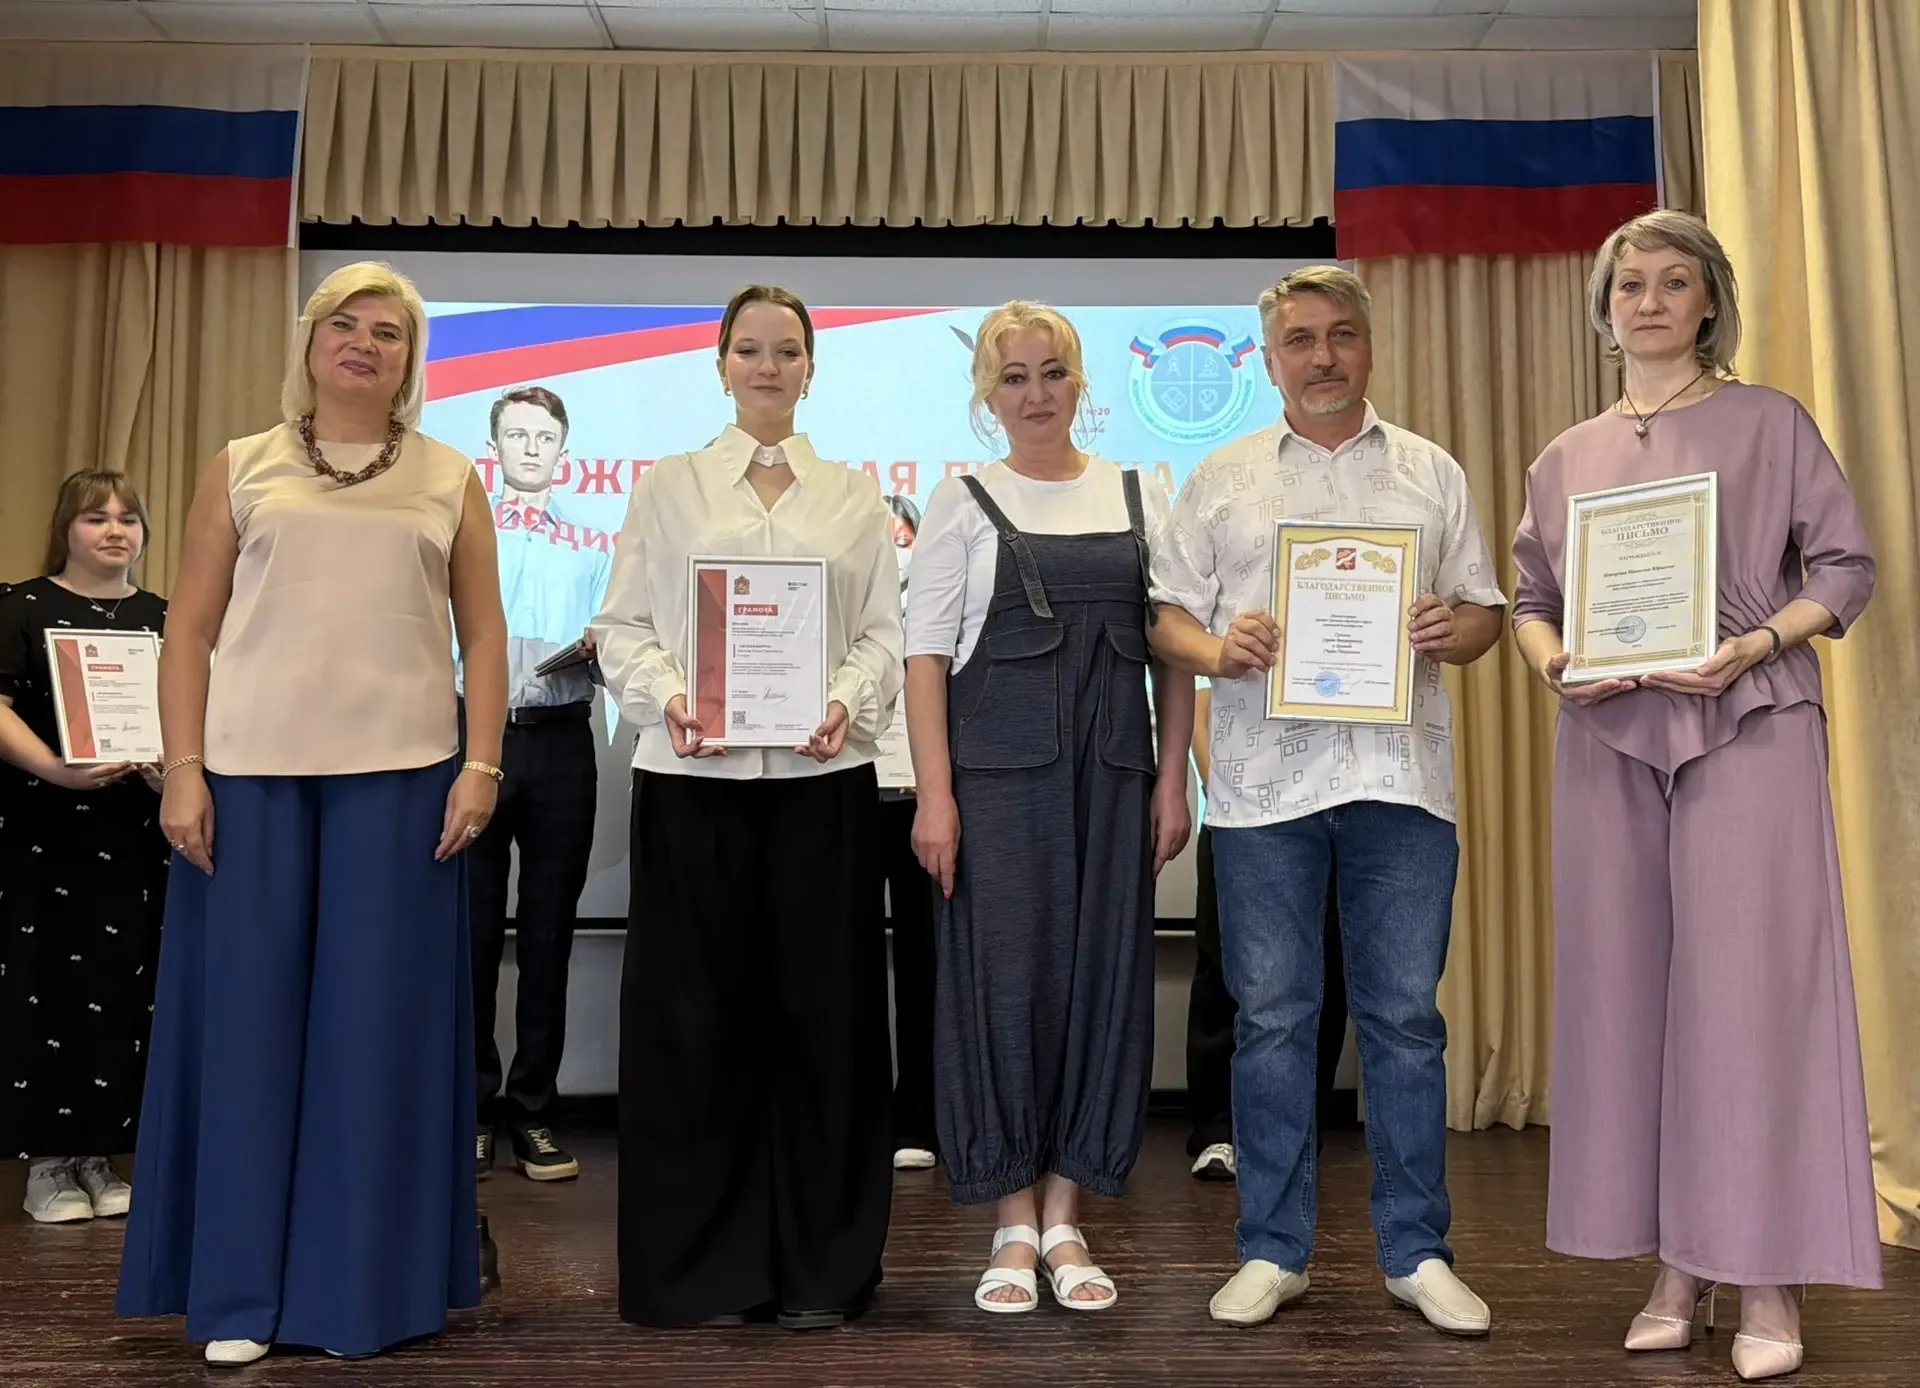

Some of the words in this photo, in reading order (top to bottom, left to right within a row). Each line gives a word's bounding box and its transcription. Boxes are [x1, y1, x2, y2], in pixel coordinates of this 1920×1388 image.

[1616, 526, 1669, 541] ПИСЬМО
[1297, 581, 1396, 593] БЛАГОДАРСТВЕННОЕ
[1325, 592, 1366, 602] ПИСЬМО
[738, 606, 774, 614] ГРАМОТА
